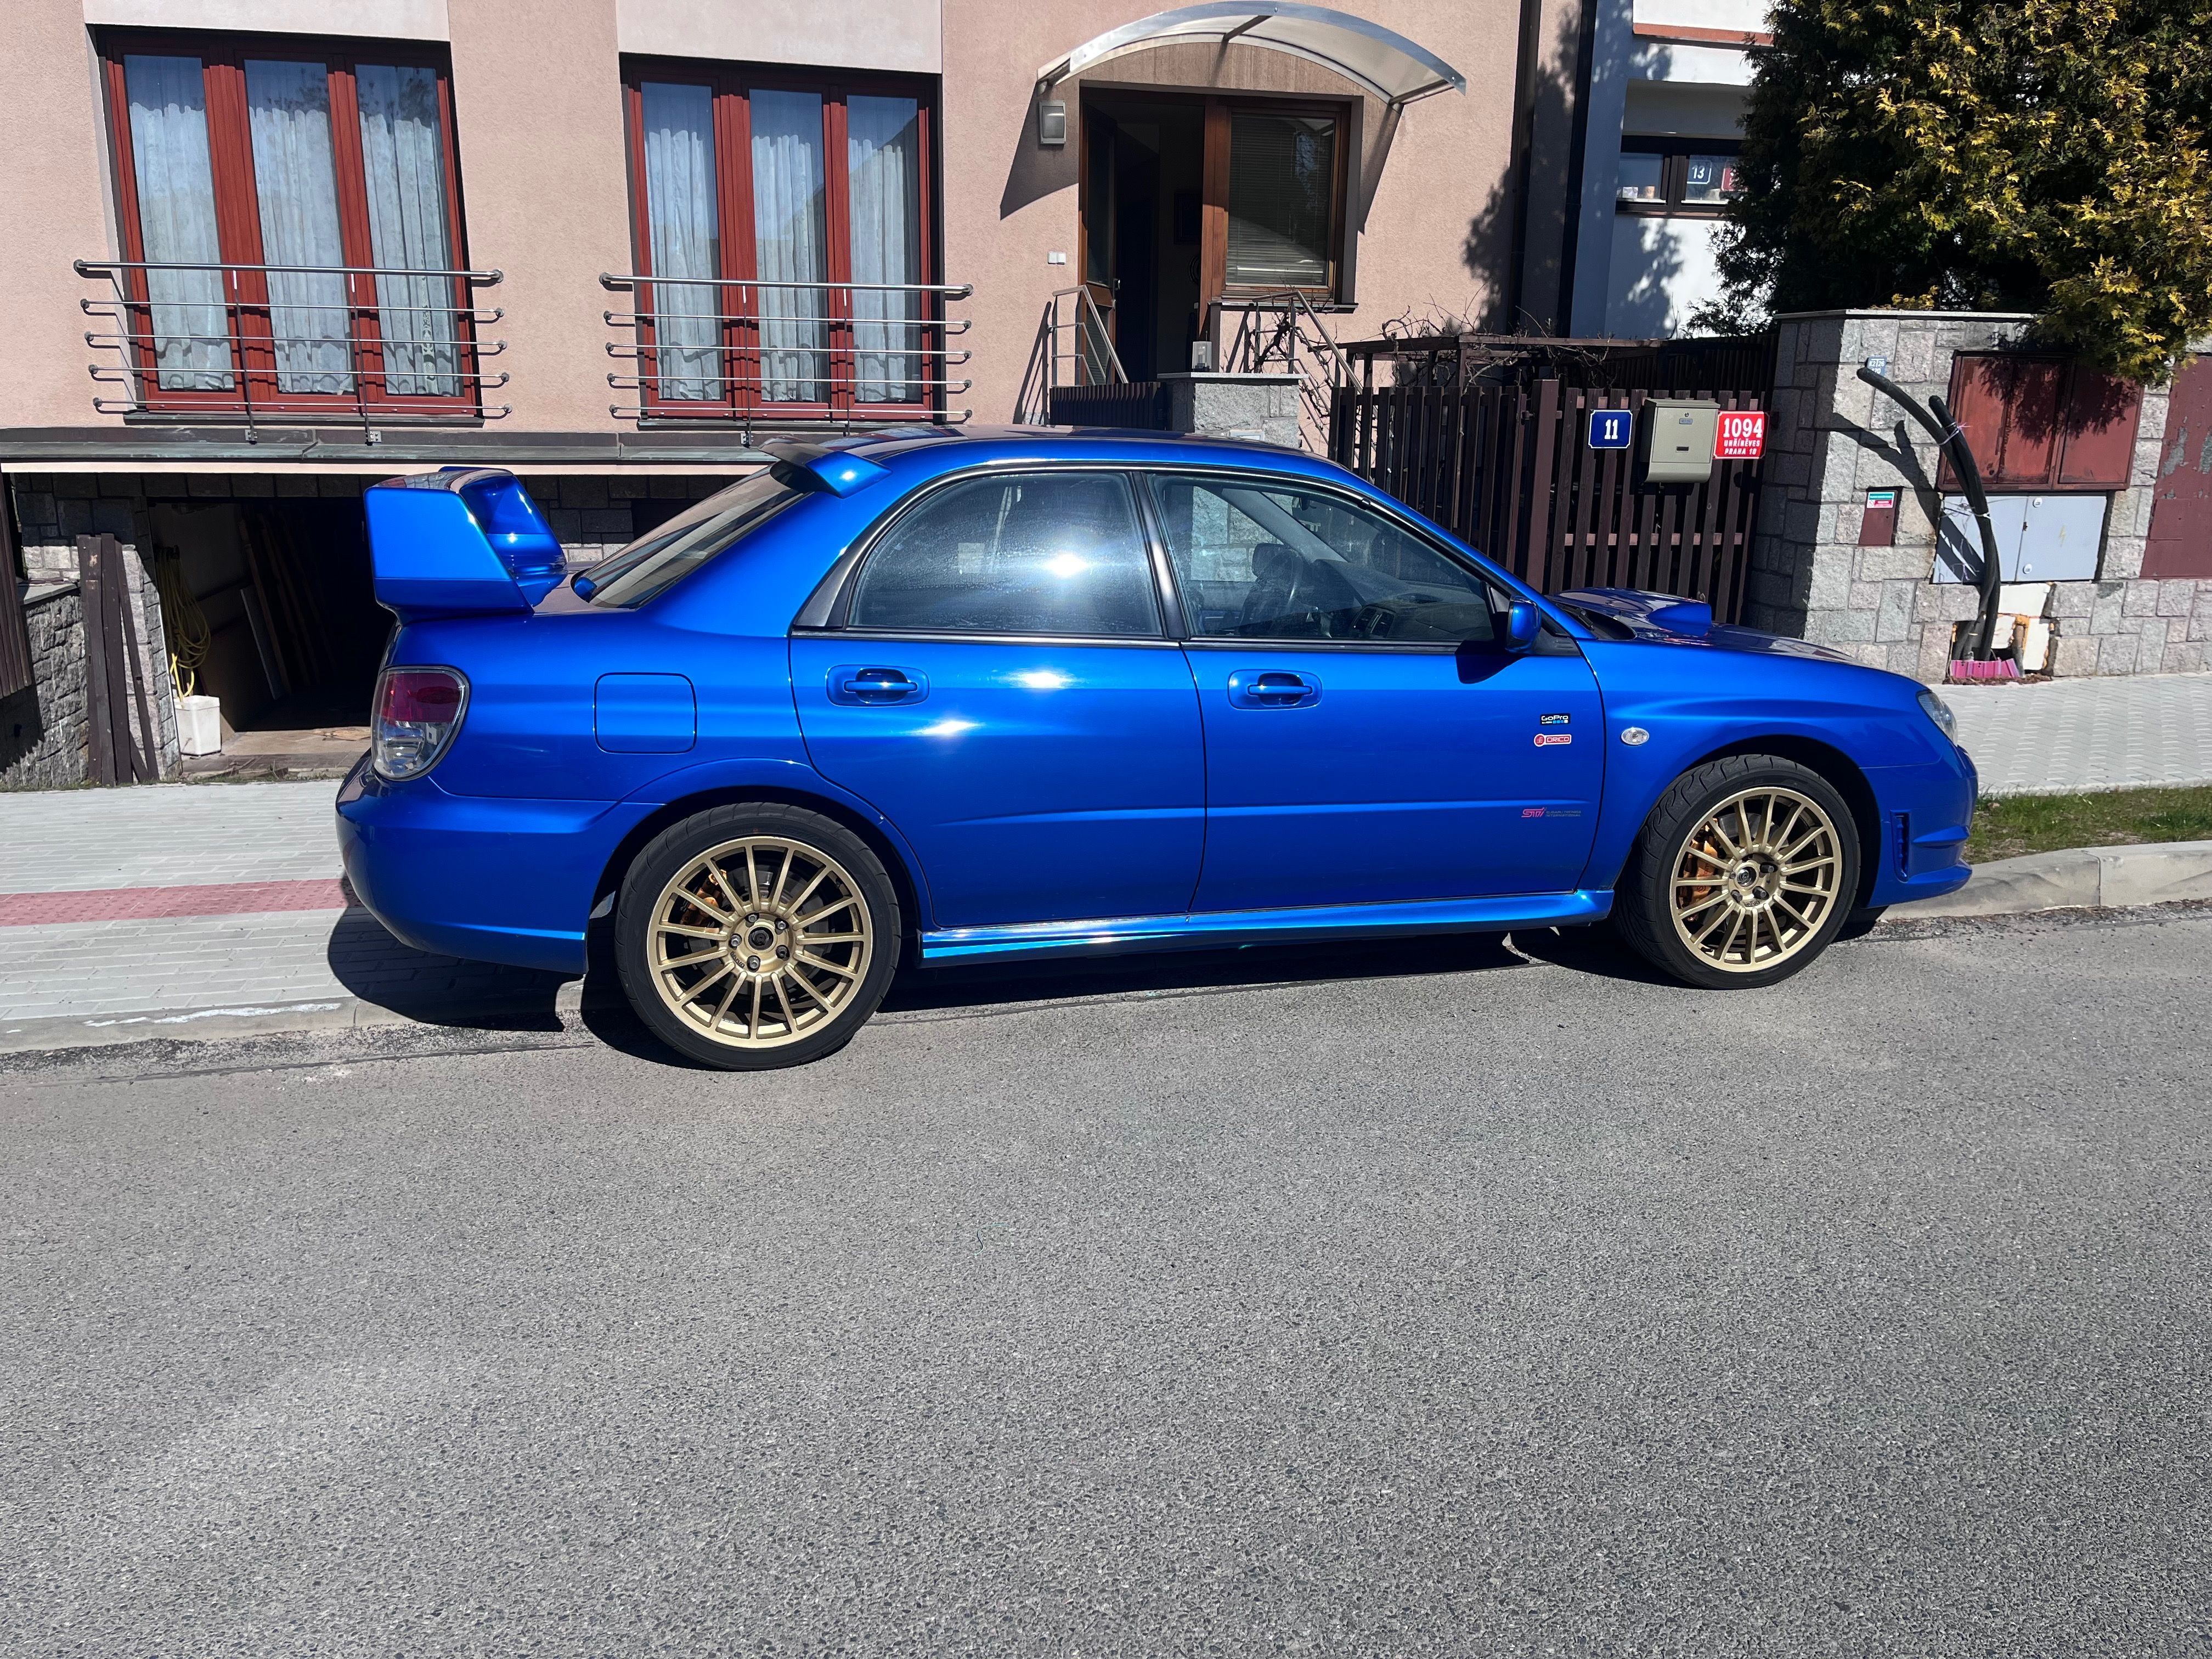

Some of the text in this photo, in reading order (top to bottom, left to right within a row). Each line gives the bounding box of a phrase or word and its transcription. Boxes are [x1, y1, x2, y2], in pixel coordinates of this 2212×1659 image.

[1692, 165, 1705, 179] 13
[1604, 419, 1618, 439] 11
[1723, 417, 1762, 438] 1094
